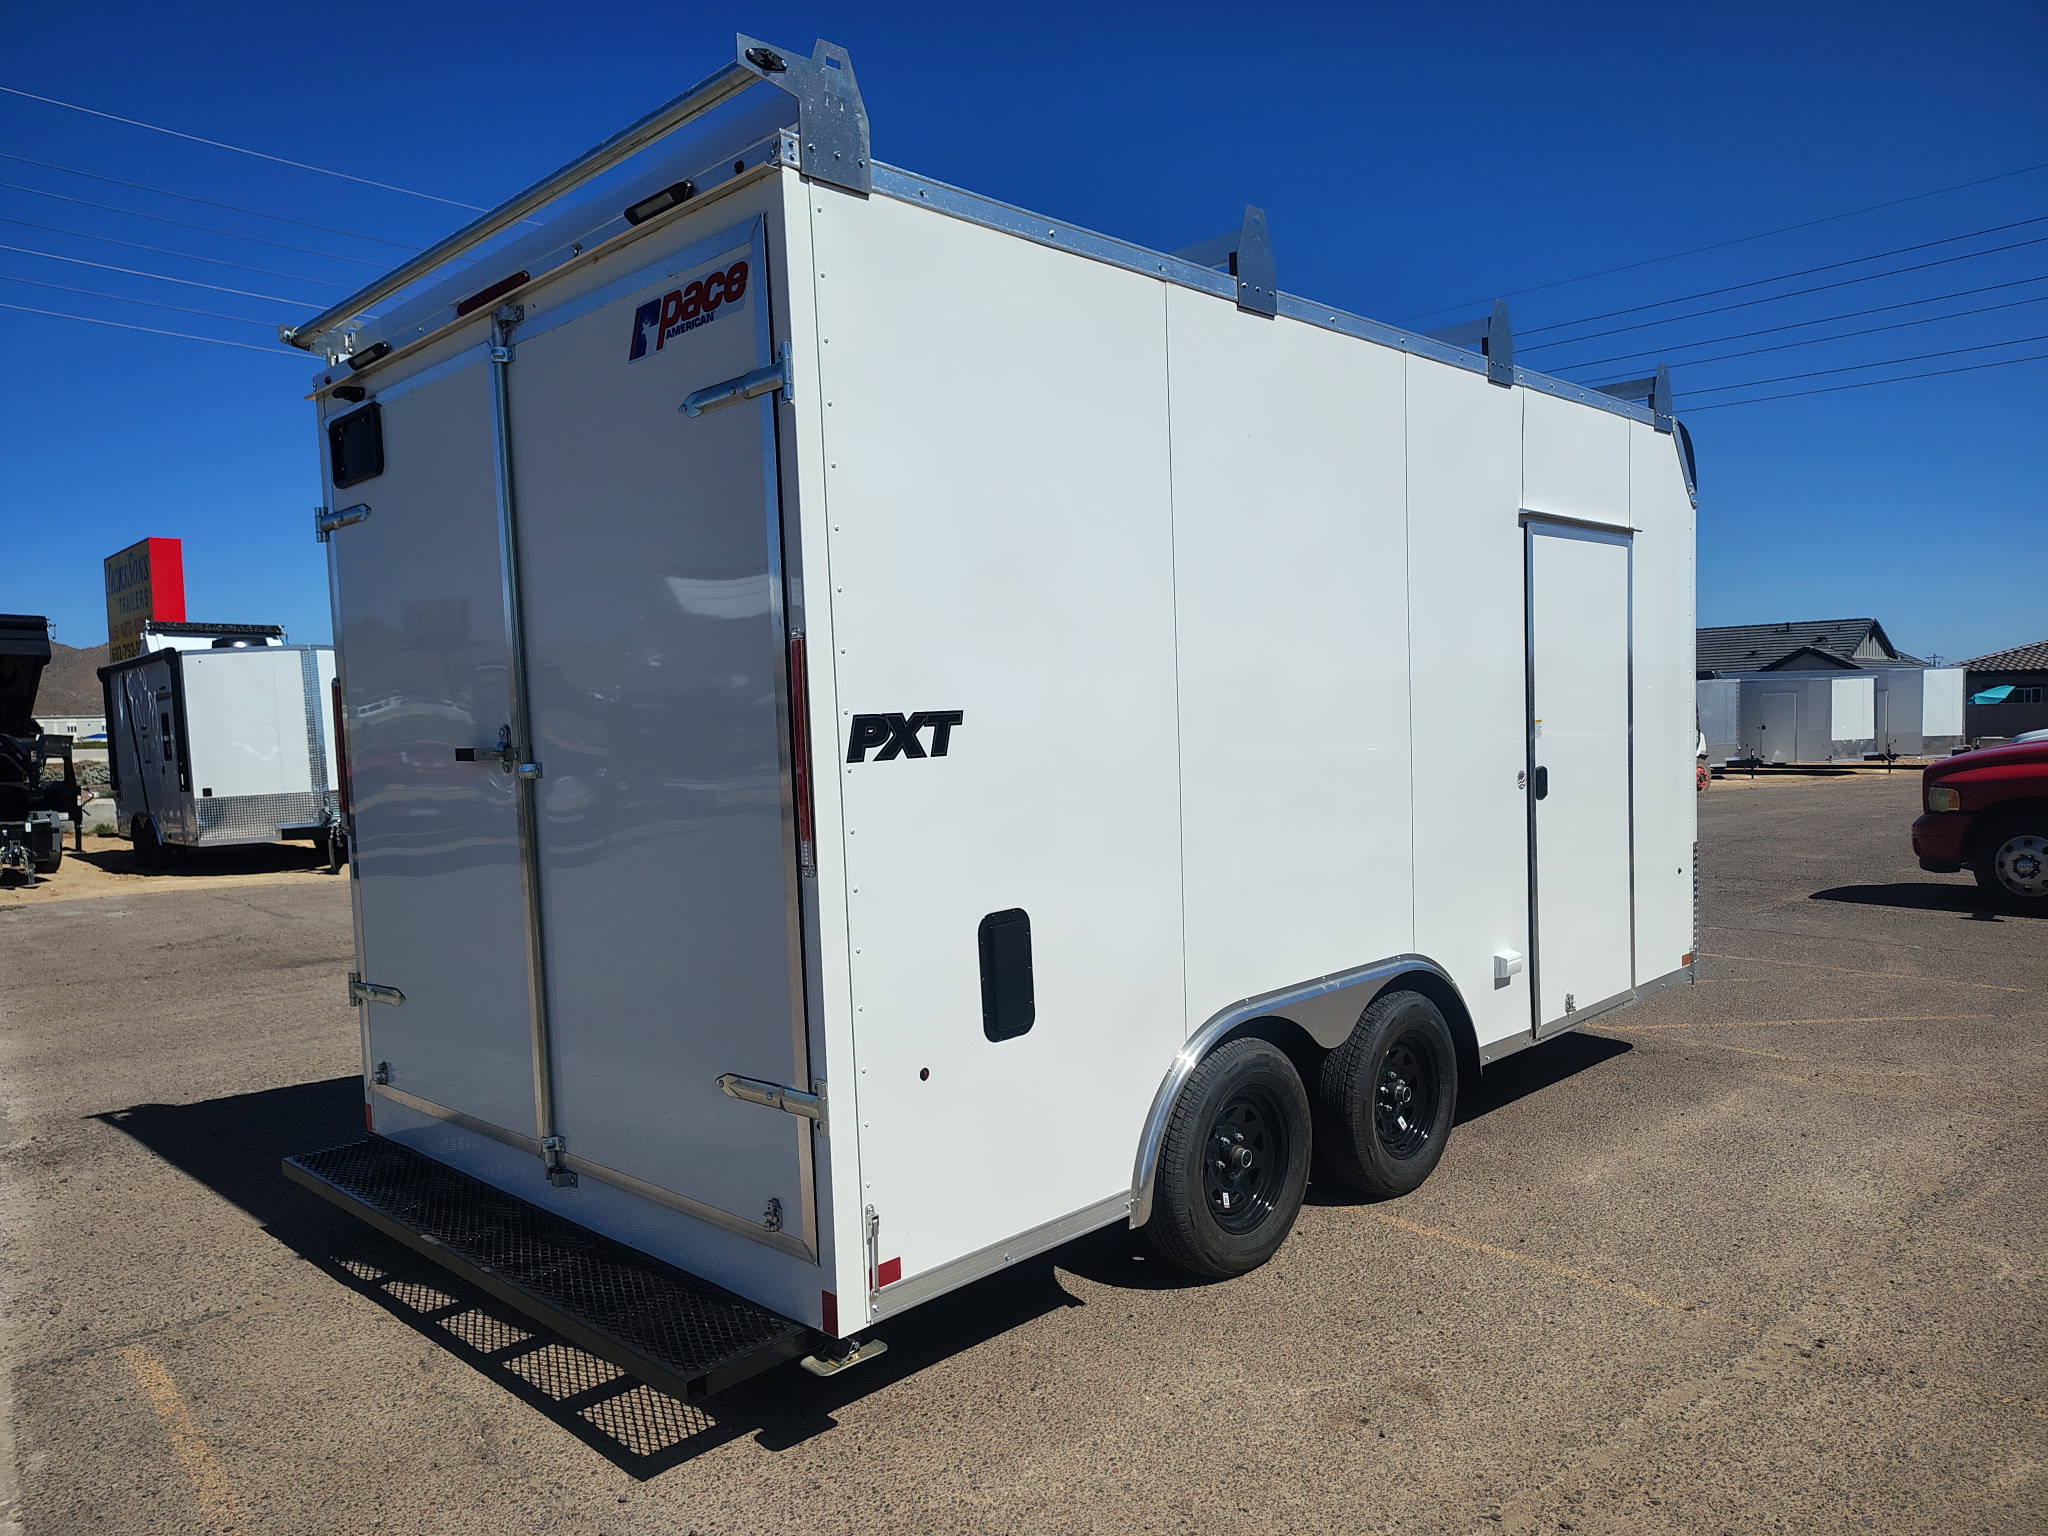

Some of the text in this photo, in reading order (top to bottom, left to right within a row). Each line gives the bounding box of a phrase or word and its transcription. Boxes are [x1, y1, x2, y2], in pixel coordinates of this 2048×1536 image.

[656, 261, 748, 351] pace
[665, 313, 714, 340] AMERICAN
[118, 589, 149, 614] TRAILERS
[846, 710, 964, 763] PXT
